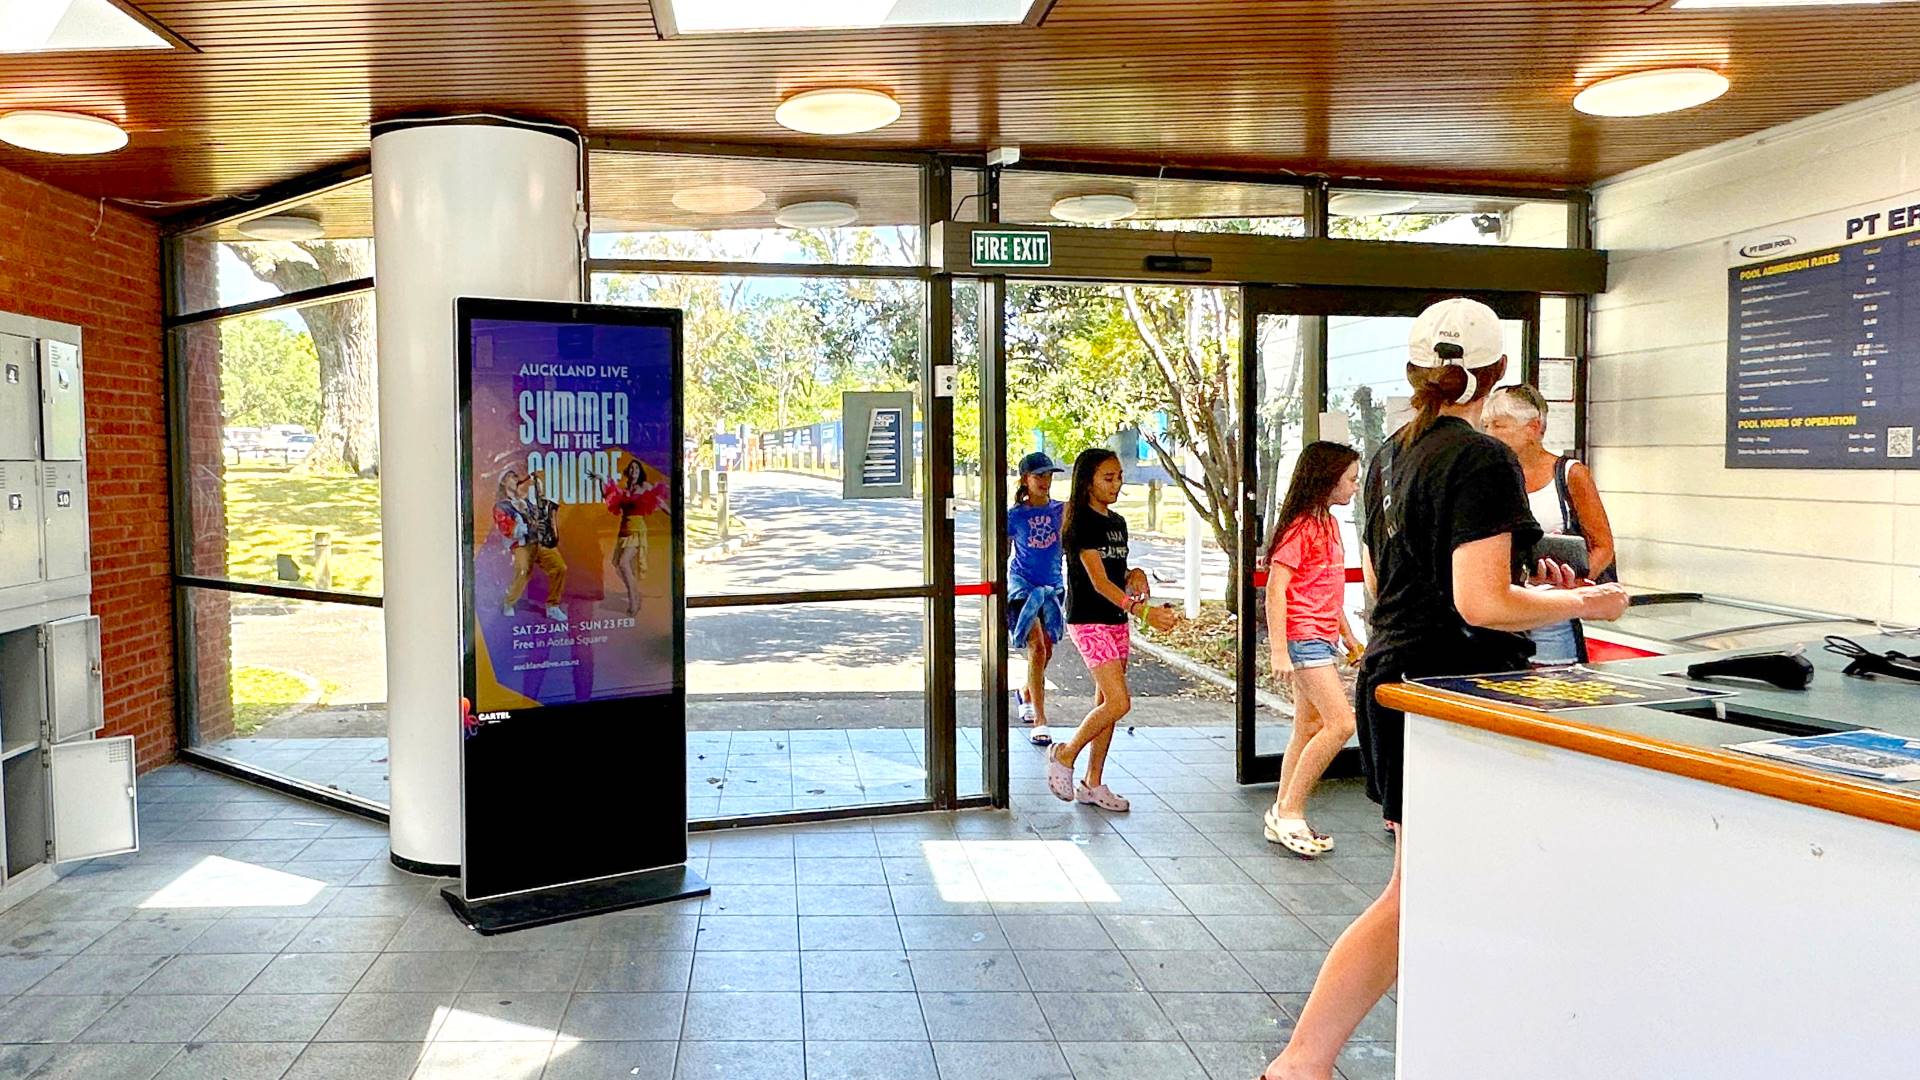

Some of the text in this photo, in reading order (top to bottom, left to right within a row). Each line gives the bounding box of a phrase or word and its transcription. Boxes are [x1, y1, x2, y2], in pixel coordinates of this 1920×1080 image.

[1846, 212, 1881, 240] PT
[976, 236, 1046, 261] FIRE EXIT
[1740, 253, 1840, 280] POOL ADMISSION RATES
[519, 363, 629, 378] AUCKLAND LIVE
[519, 390, 629, 444] SUMMER
[1738, 415, 1857, 429] POOL HOURS OF OPERATION
[573, 433, 600, 449] THE
[11, 495, 20, 510] 9
[58, 493, 70, 506] 10
[513, 625, 532, 636] SAT
[534, 624, 547, 634] 25
[548, 623, 569, 633] JAN
[580, 620, 601, 631] SUN
[603, 619, 615, 629] 23
[617, 618, 635, 628] FEB
[513, 634, 608, 650] Free in Aotea Square
[513, 659, 580, 671] aucklandlive.co.nz
[478, 711, 511, 722] CARTEL
